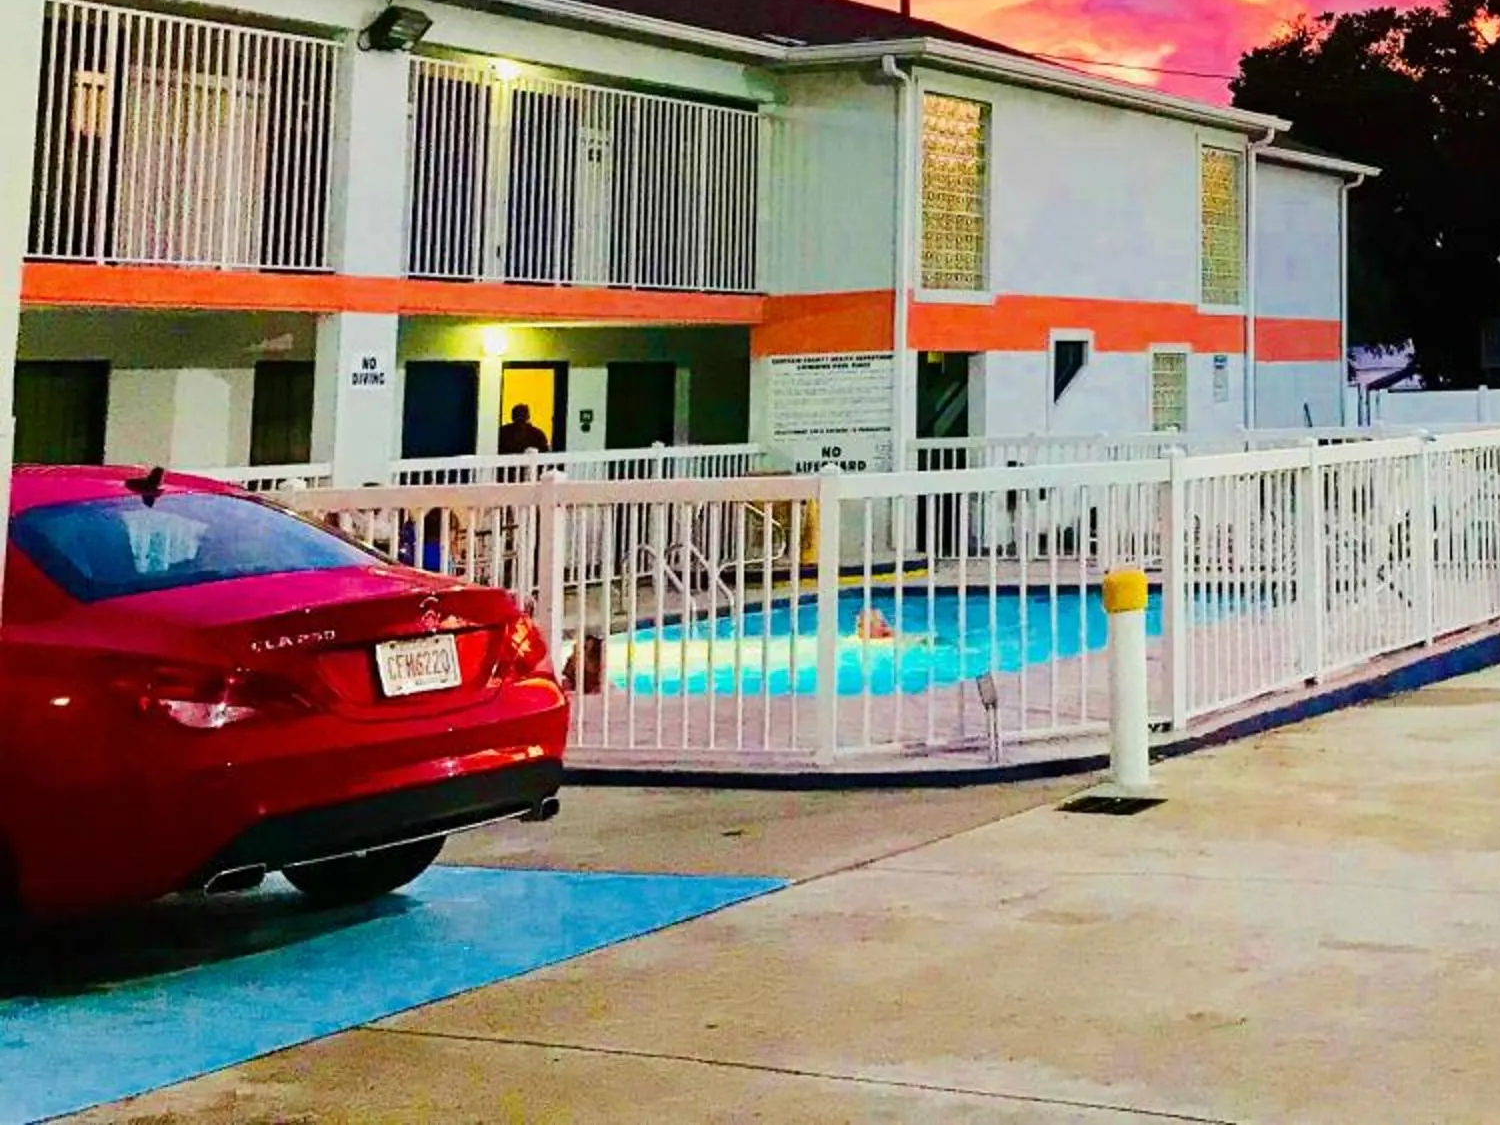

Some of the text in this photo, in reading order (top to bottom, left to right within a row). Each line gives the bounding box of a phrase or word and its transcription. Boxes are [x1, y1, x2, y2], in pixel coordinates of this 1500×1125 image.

[362, 357, 377, 370] NO
[352, 372, 385, 385] DIVING
[821, 446, 842, 458] NO
[795, 460, 867, 473] LIFEARD
